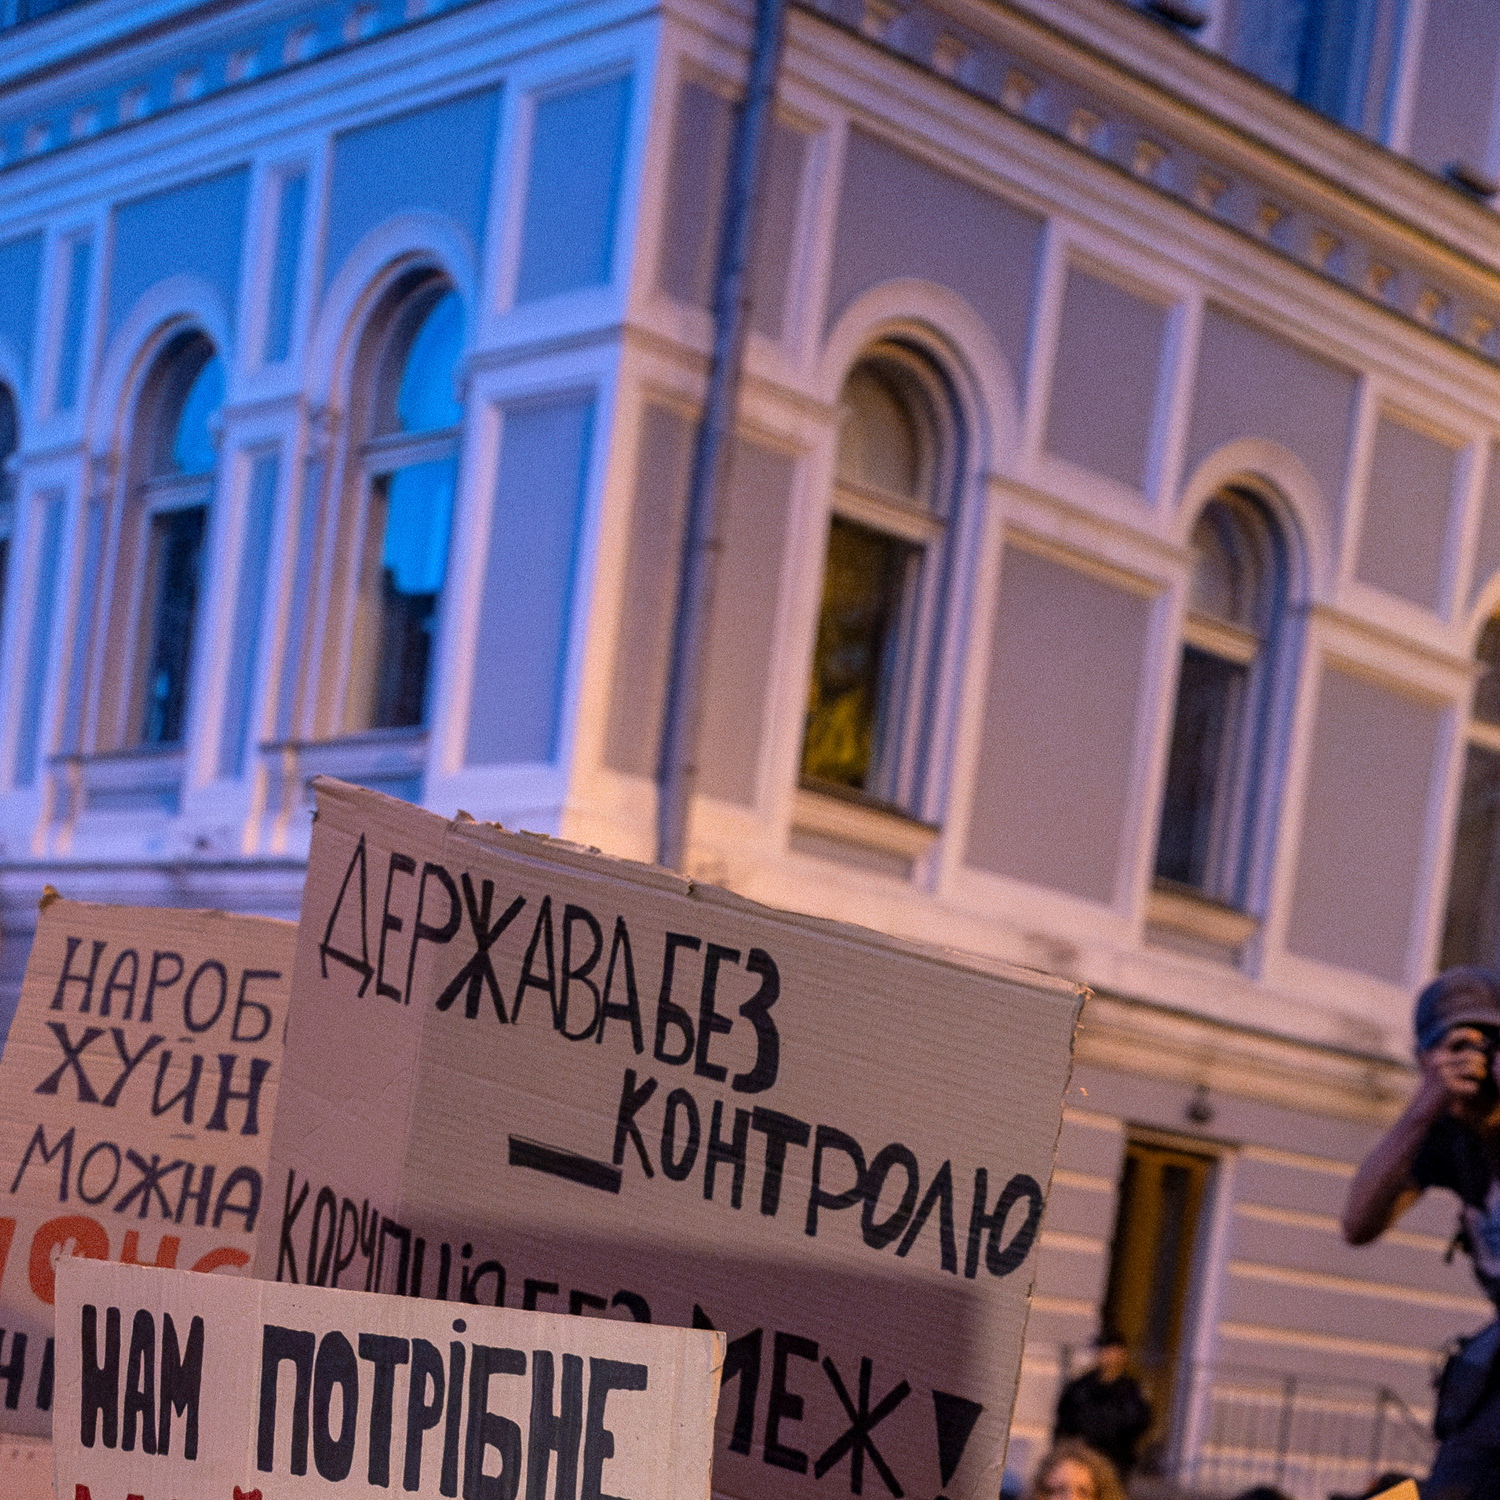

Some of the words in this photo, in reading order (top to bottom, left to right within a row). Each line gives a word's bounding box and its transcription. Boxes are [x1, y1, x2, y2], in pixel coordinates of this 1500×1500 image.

[50, 936, 283, 1043] НАРОБ
[320, 833, 646, 1056] ДЕРЖАВА
[652, 931, 781, 1095] БЕЗ
[34, 1022, 272, 1135] ХУЙН
[9, 1123, 264, 1233] МОЖНА
[612, 1068, 1043, 1281] КОНТРОЛЮ
[81, 1304, 205, 1460] НАМ
